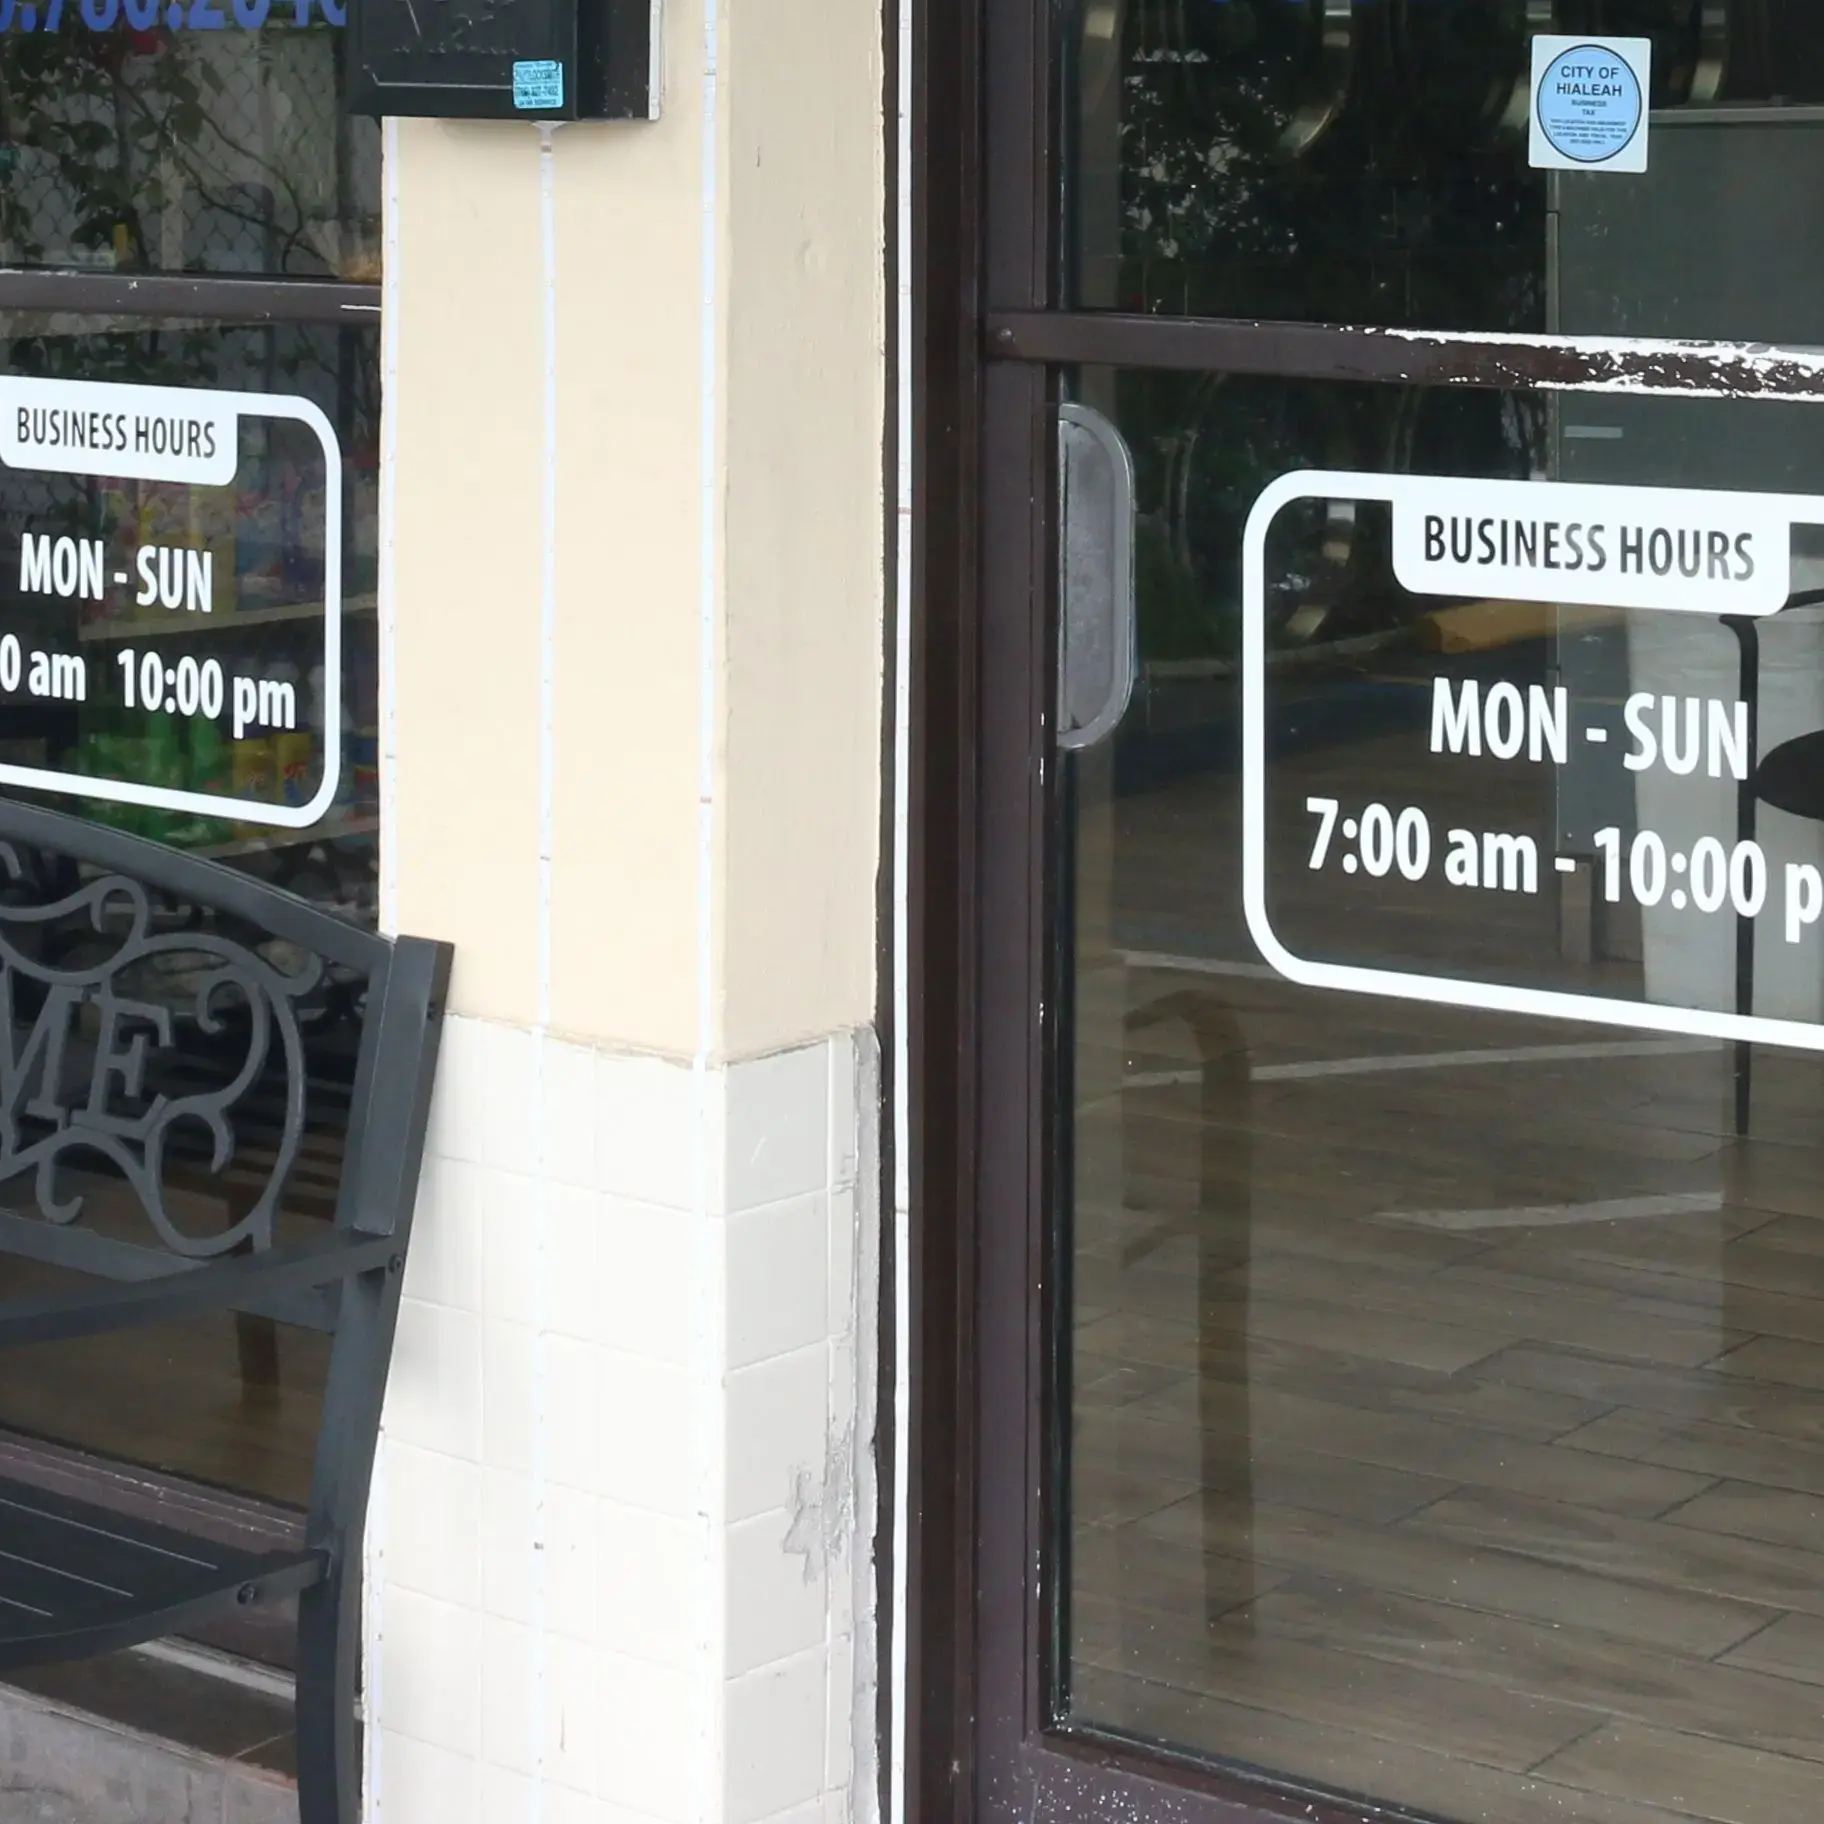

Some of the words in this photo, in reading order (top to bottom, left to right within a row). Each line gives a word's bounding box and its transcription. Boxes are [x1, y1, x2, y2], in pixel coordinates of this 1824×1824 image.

[1556, 82, 1622, 97] HIALEAH
[1560, 65, 1594, 78] CITY
[1598, 66, 1620, 79] OF
[1581, 108, 1596, 116] TAX
[16, 406, 127, 454] BUSINESS
[134, 414, 216, 460] HOURS
[19, 531, 105, 601] MON
[113, 571, 128, 584] -
[135, 544, 213, 613] SUN
[1423, 514, 1607, 573] BUSINESS
[1619, 525, 1756, 582] HOURS
[28, 648, 86, 702] am
[117, 648, 224, 720] 10:00
[232, 675, 296, 739] pm
[1429, 676, 1568, 765] MON
[1585, 727, 1608, 742] -
[1622, 691, 1749, 781] SUN
[1306, 797, 1432, 882] 7:00
[1444, 828, 1538, 894] am
[1553, 857, 1576, 873] -
[1593, 825, 1768, 918] 10:00
